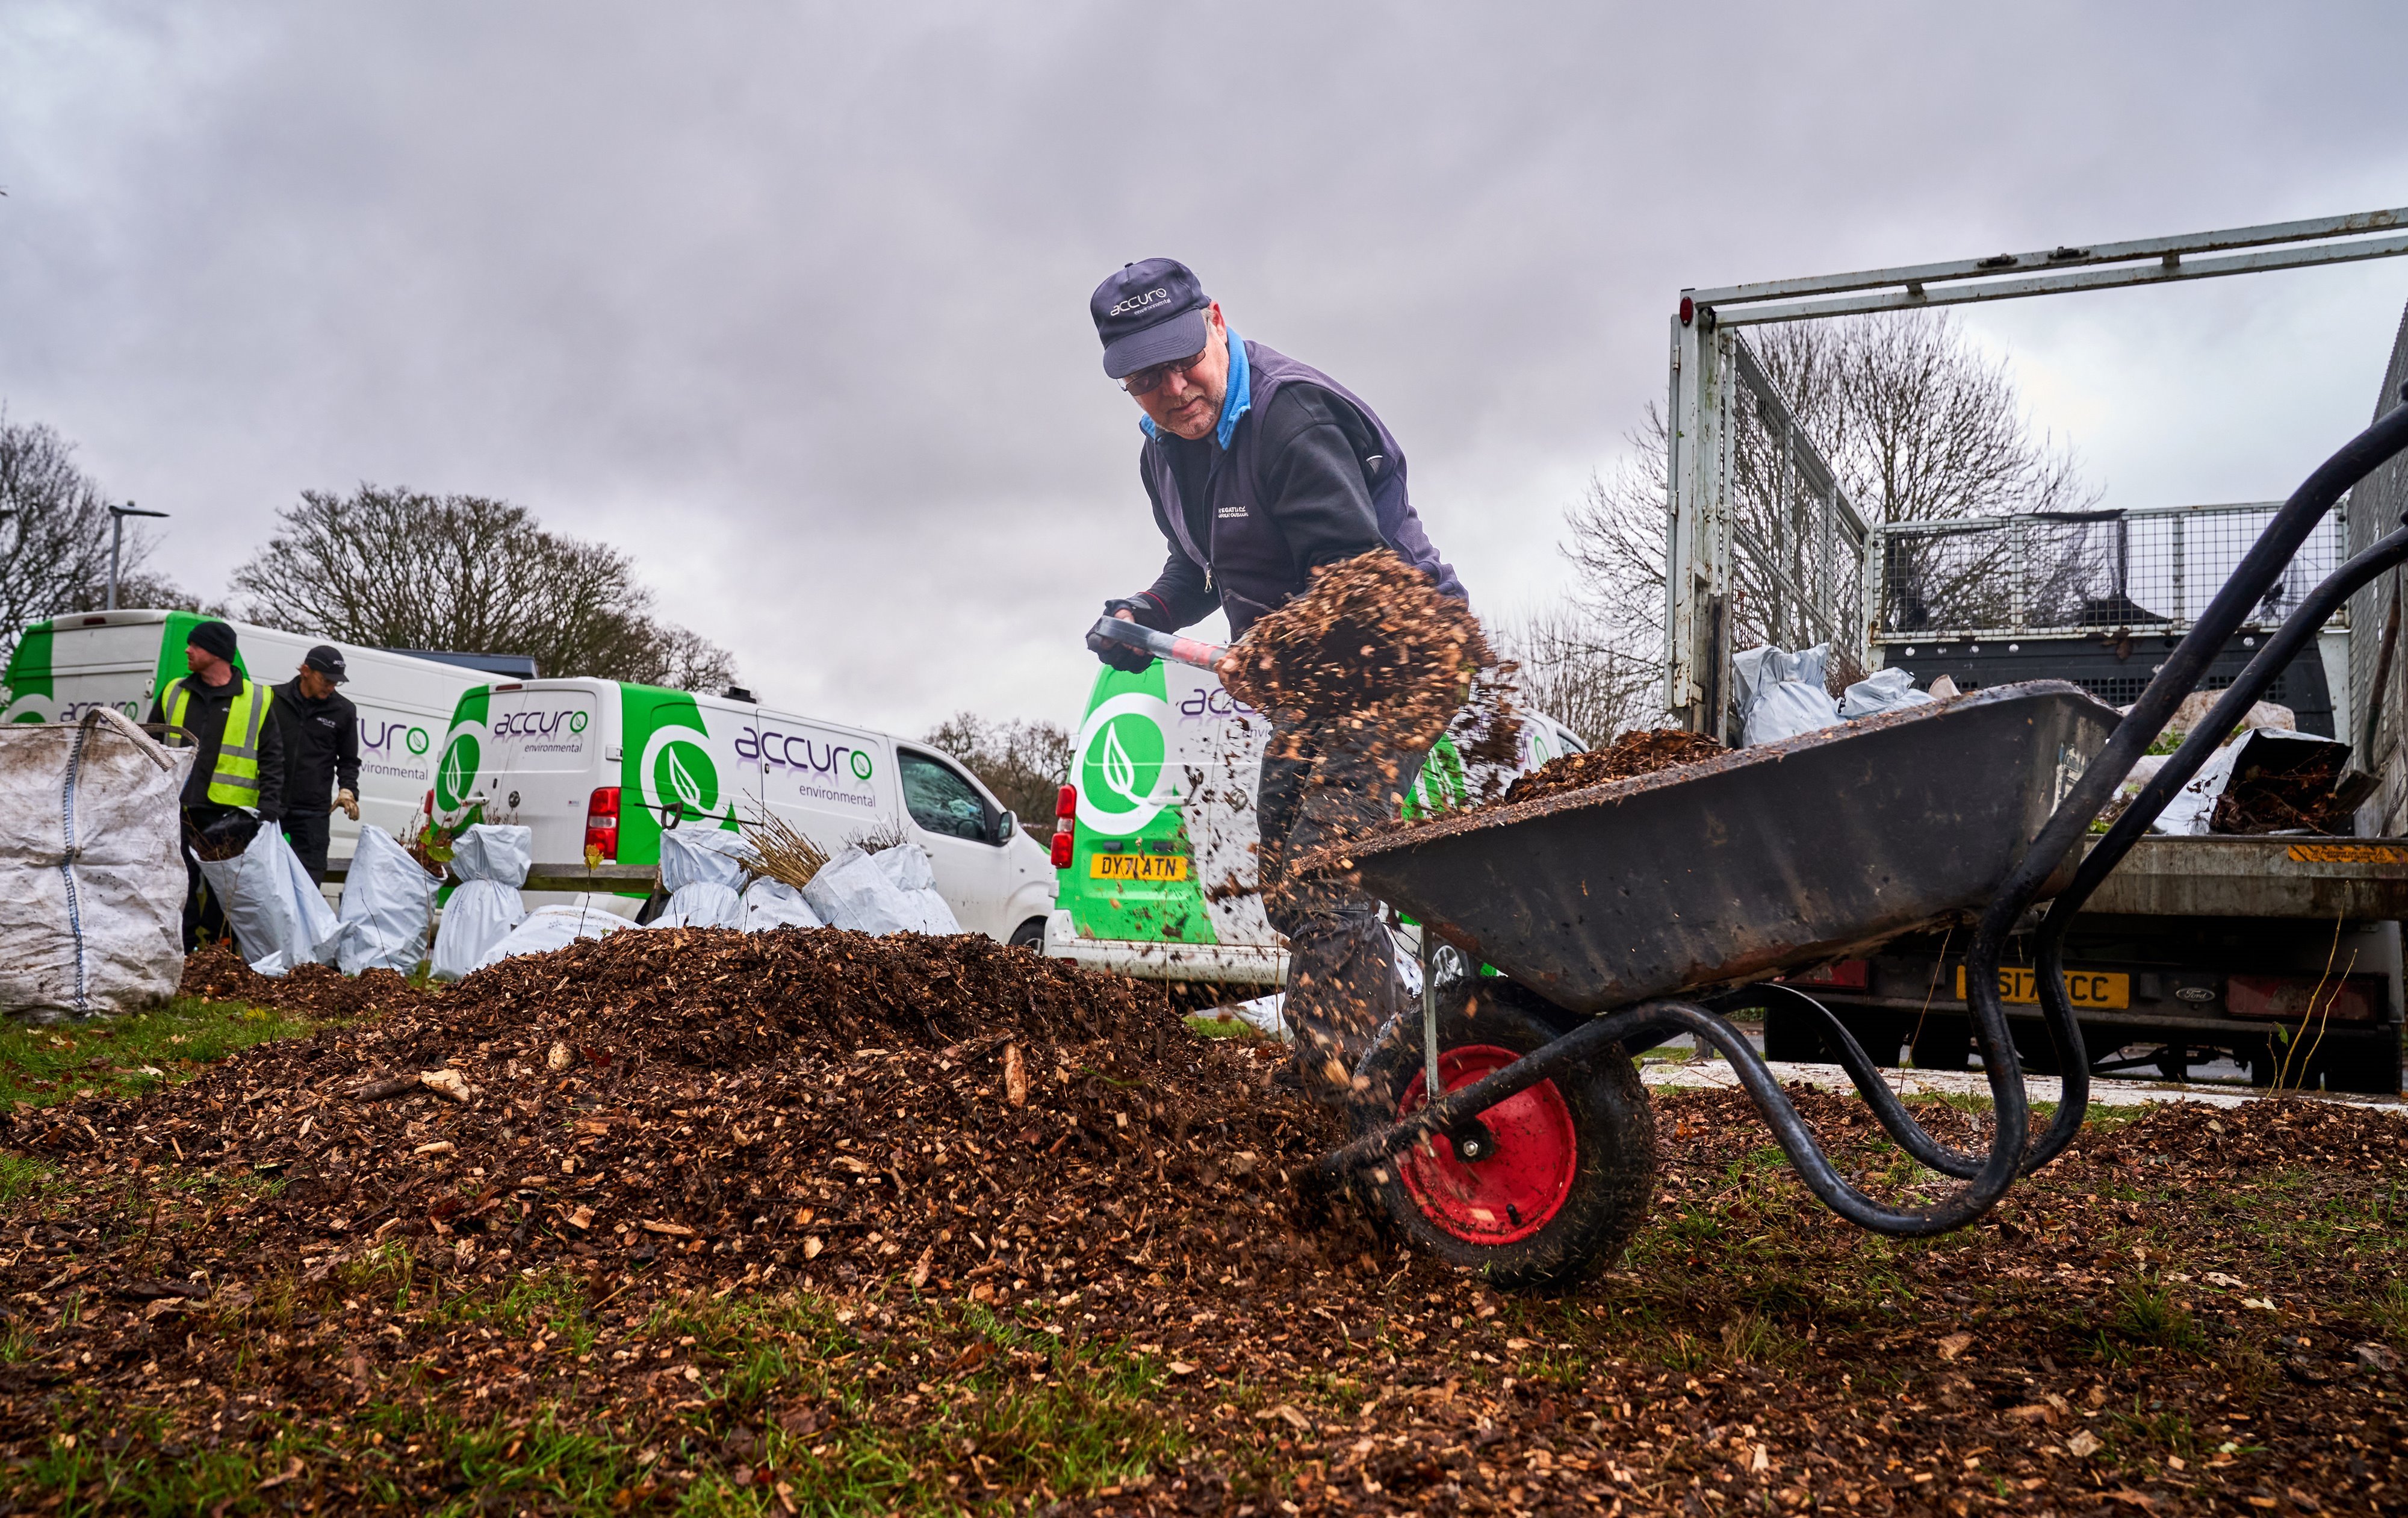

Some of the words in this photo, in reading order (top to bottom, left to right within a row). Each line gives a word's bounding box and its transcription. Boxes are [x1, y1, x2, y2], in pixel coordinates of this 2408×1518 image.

[1110, 288, 1167, 316] accuro
[1134, 297, 1171, 315] environmental
[1181, 688, 1255, 715] acc
[494, 711, 588, 735] accuro
[356, 717, 429, 755] uro
[524, 742, 583, 753] environmental
[734, 726, 872, 780] accuro
[361, 760, 429, 780] vironmental
[799, 785, 877, 807] environmental
[1143, 858, 1176, 876] ATN
[1998, 971, 2038, 998] S17
[2063, 975, 2109, 1002] CC
